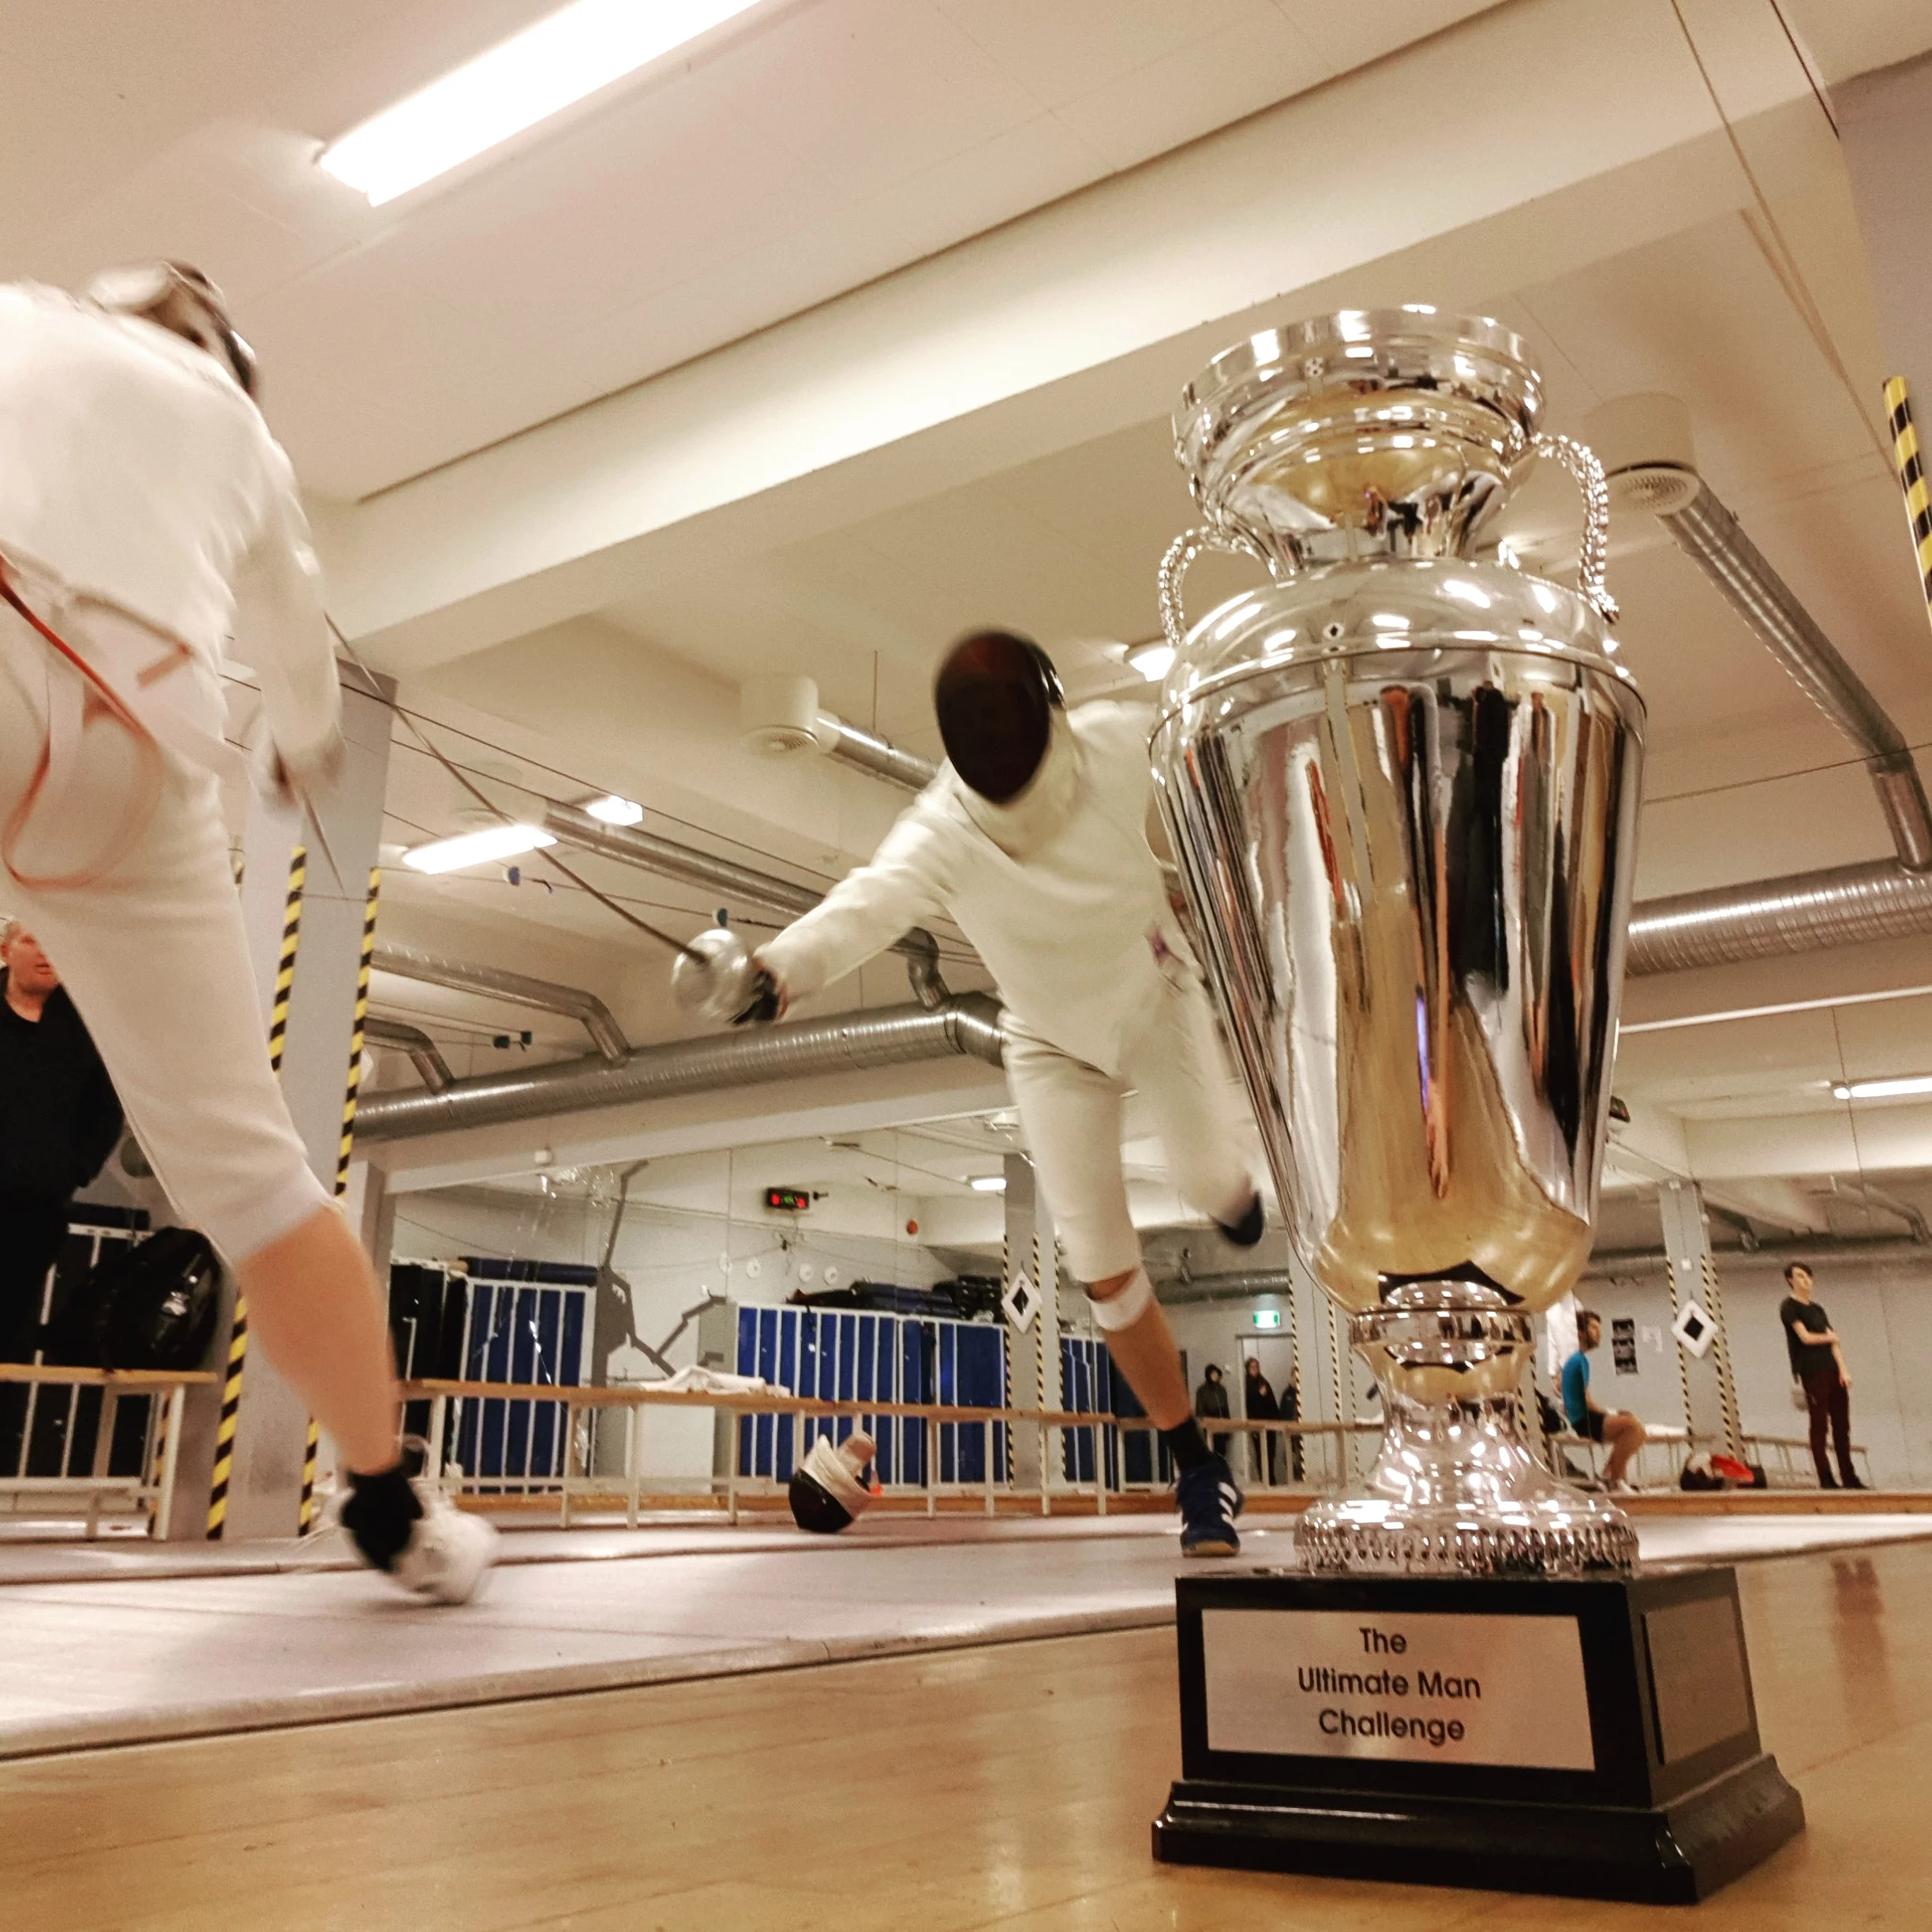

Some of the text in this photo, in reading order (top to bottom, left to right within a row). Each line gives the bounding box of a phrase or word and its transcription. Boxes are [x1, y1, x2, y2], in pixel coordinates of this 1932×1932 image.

[1358, 1627, 1407, 1655] The
[1297, 1666, 1481, 1699] Ultimate Man
[1318, 1707, 1466, 1748] Challenge
